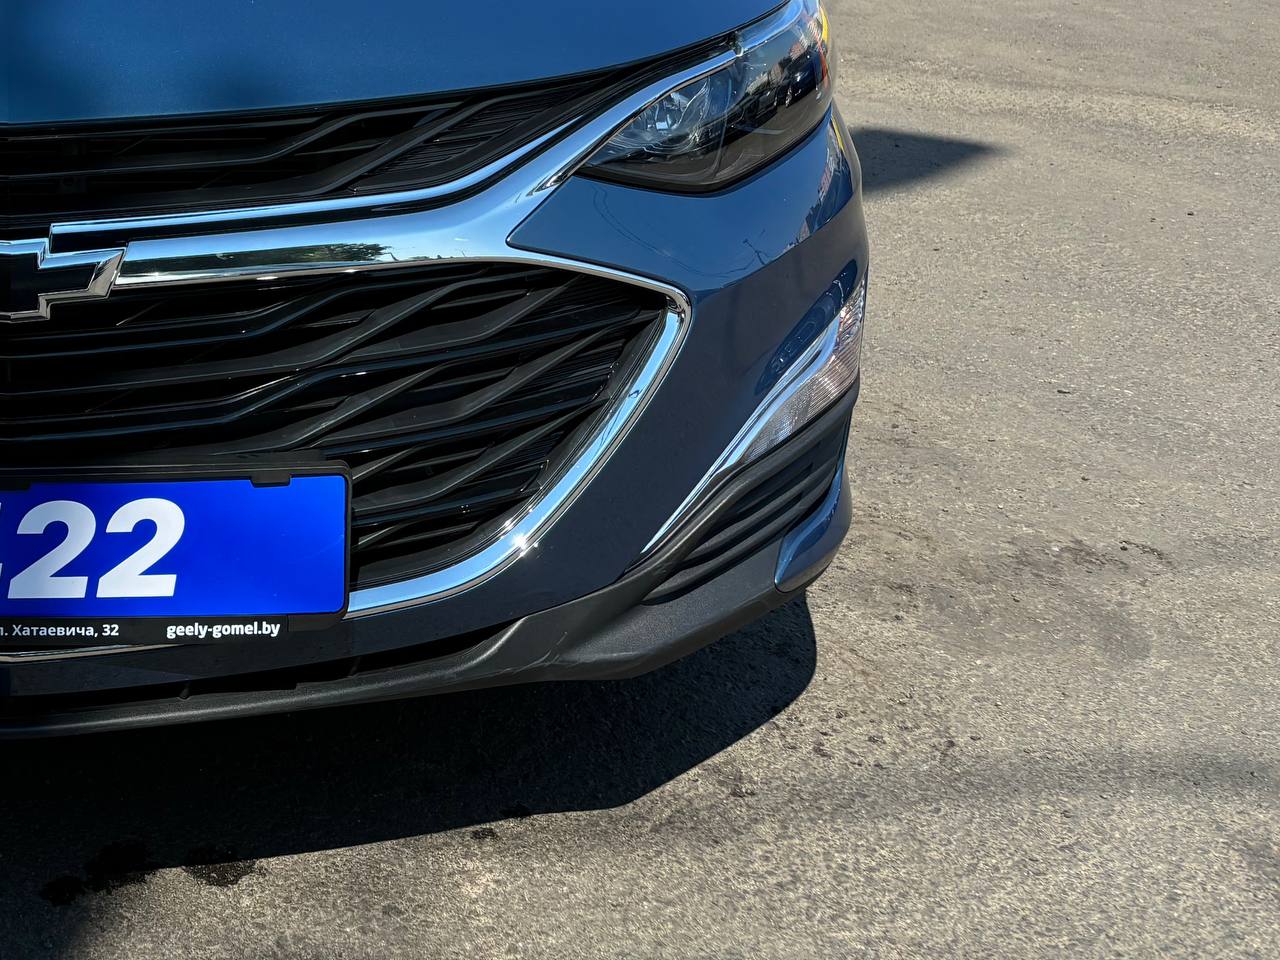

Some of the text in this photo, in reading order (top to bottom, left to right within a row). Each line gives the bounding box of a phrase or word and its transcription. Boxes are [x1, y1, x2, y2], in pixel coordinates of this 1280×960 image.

[12, 624, 98, 638] Хатаевича,
[101, 624, 120, 636] 32
[166, 621, 280, 639] geely-gomel.by
